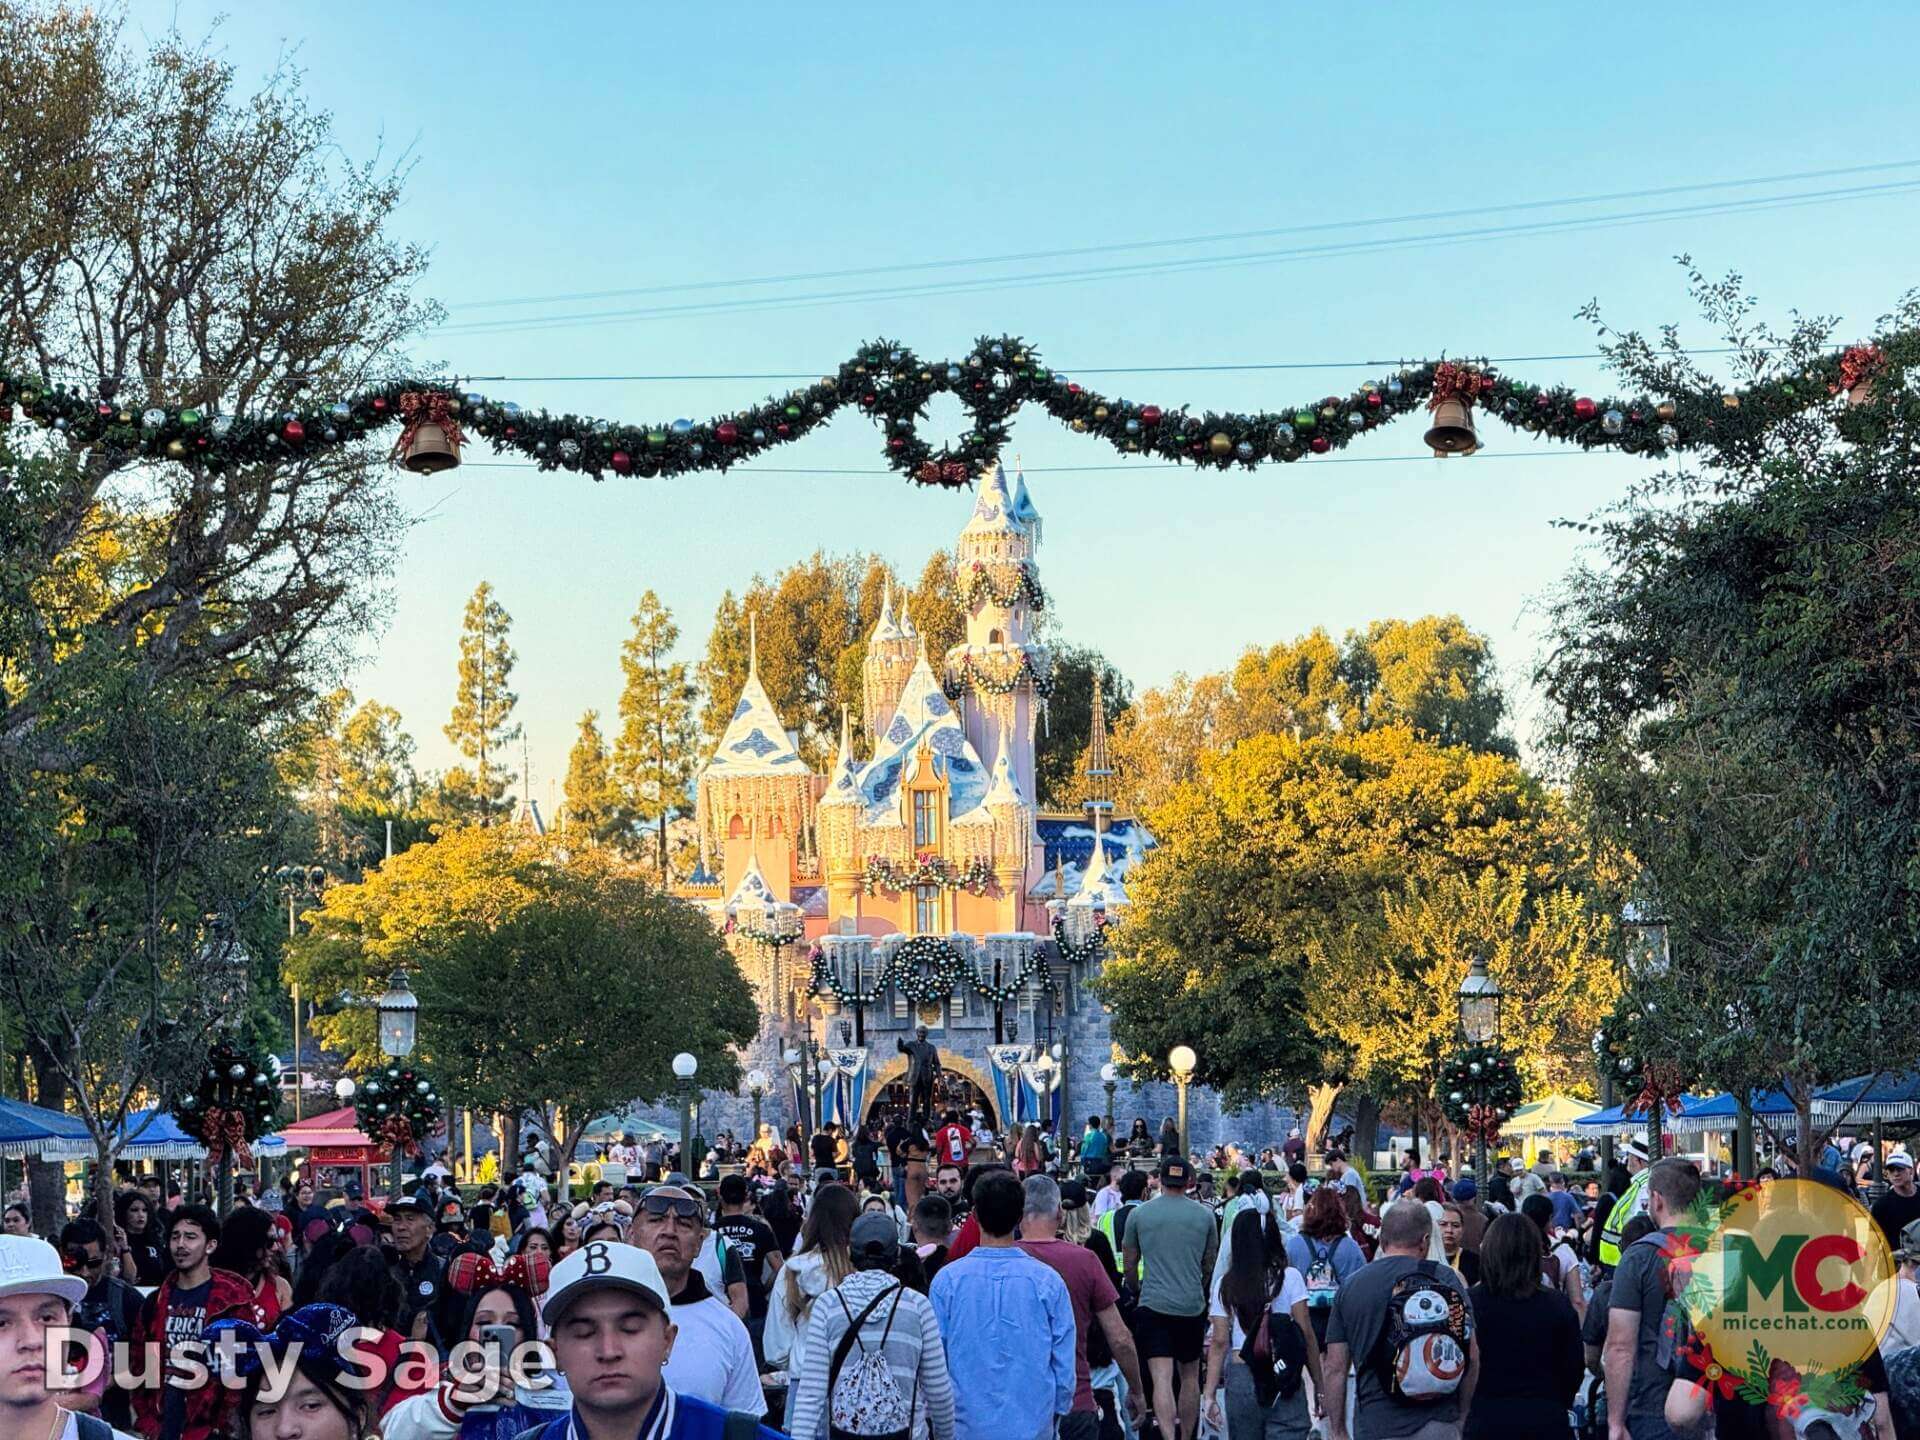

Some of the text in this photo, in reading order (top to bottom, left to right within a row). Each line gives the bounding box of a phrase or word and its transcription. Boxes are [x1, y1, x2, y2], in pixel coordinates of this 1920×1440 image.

[718, 1225, 754, 1236] ETHOD
[582, 1242, 612, 1278] B
[165, 1315, 204, 1335] ERICA
